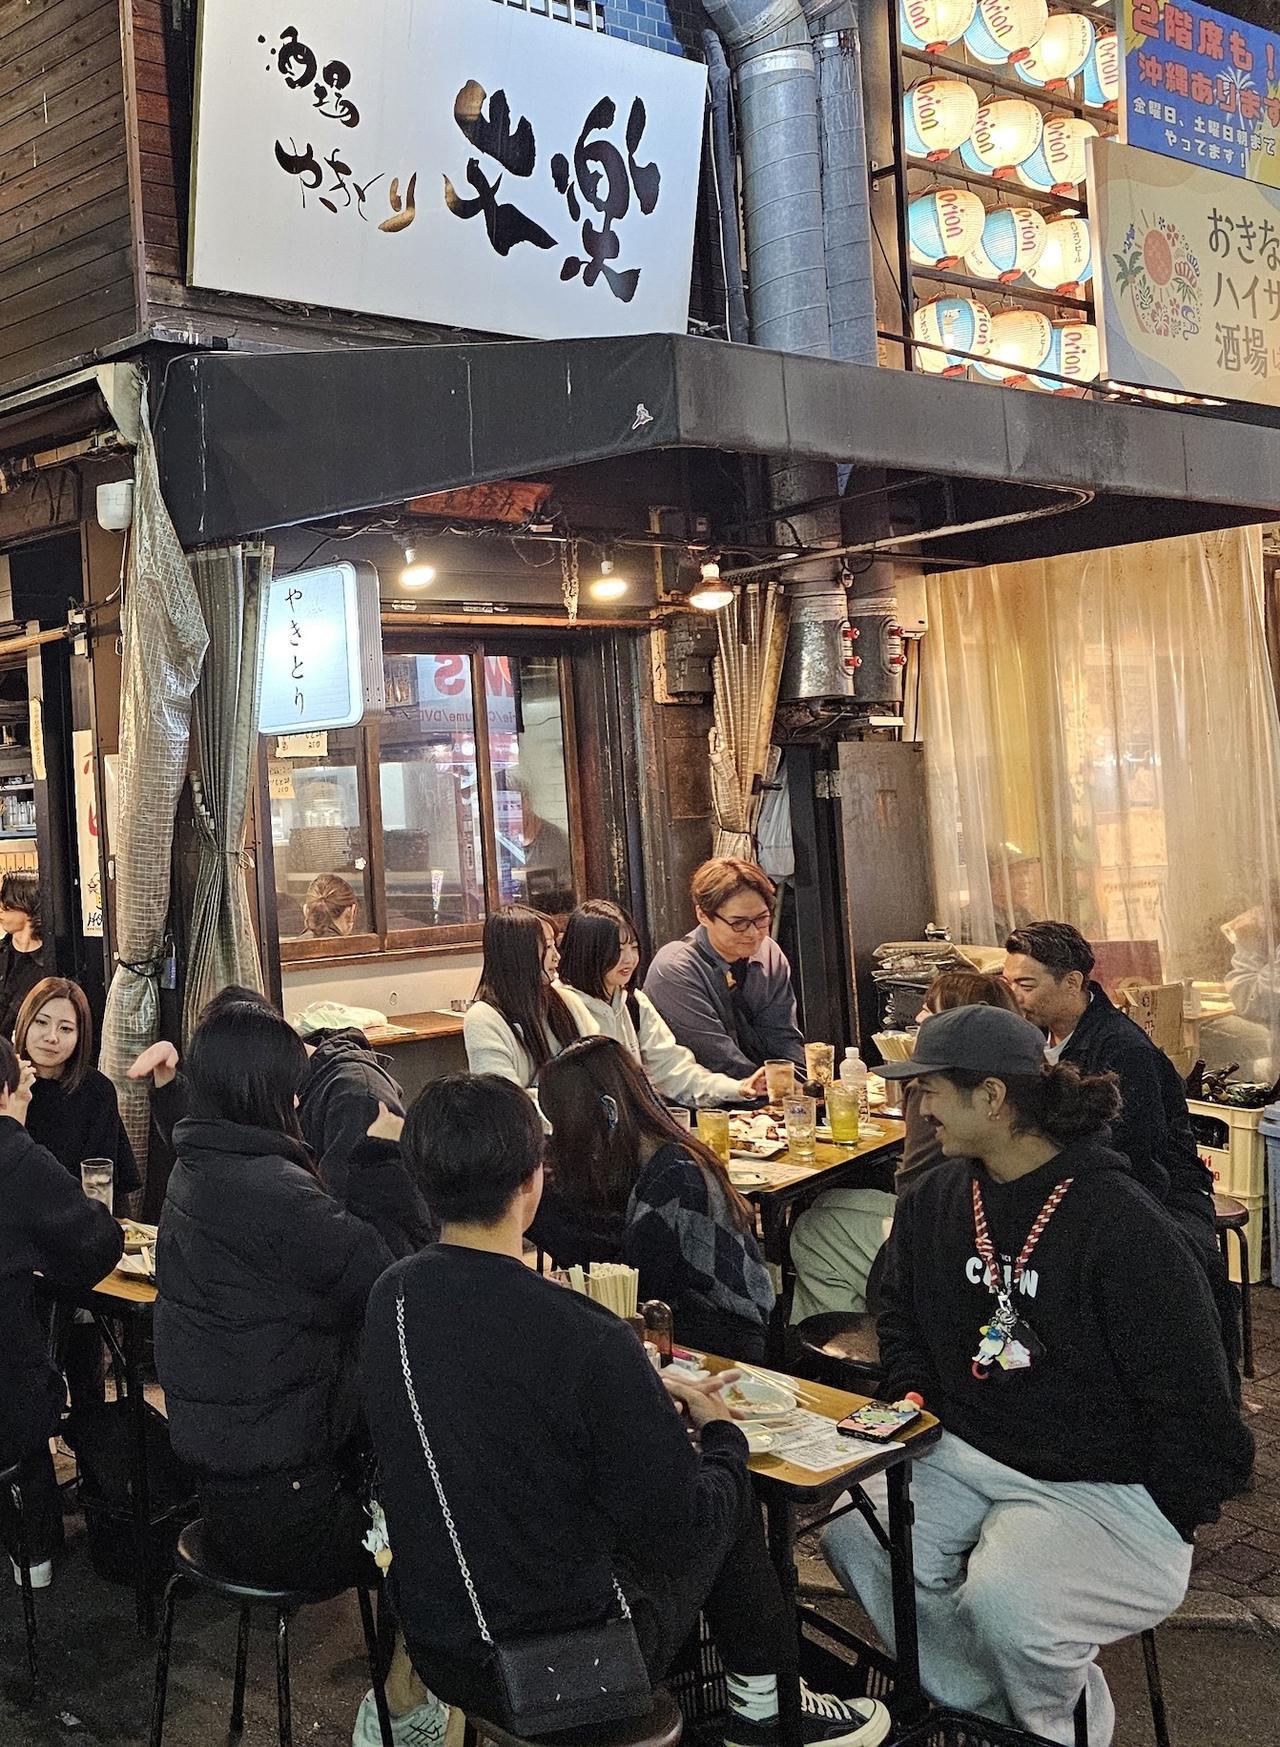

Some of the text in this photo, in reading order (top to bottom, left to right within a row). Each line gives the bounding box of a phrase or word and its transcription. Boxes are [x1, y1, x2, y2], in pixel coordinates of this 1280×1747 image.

[917, 84, 942, 131] Orion
[975, 107, 996, 154] Orion
[1047, 122, 1071, 163] Orion
[938, 191, 965, 239] Orion
[1015, 209, 1040, 251] Orion
[1064, 331, 1087, 375] Orion
[1215, 321, 1268, 378] 酒場
[285, 588, 305, 716] やきとり
